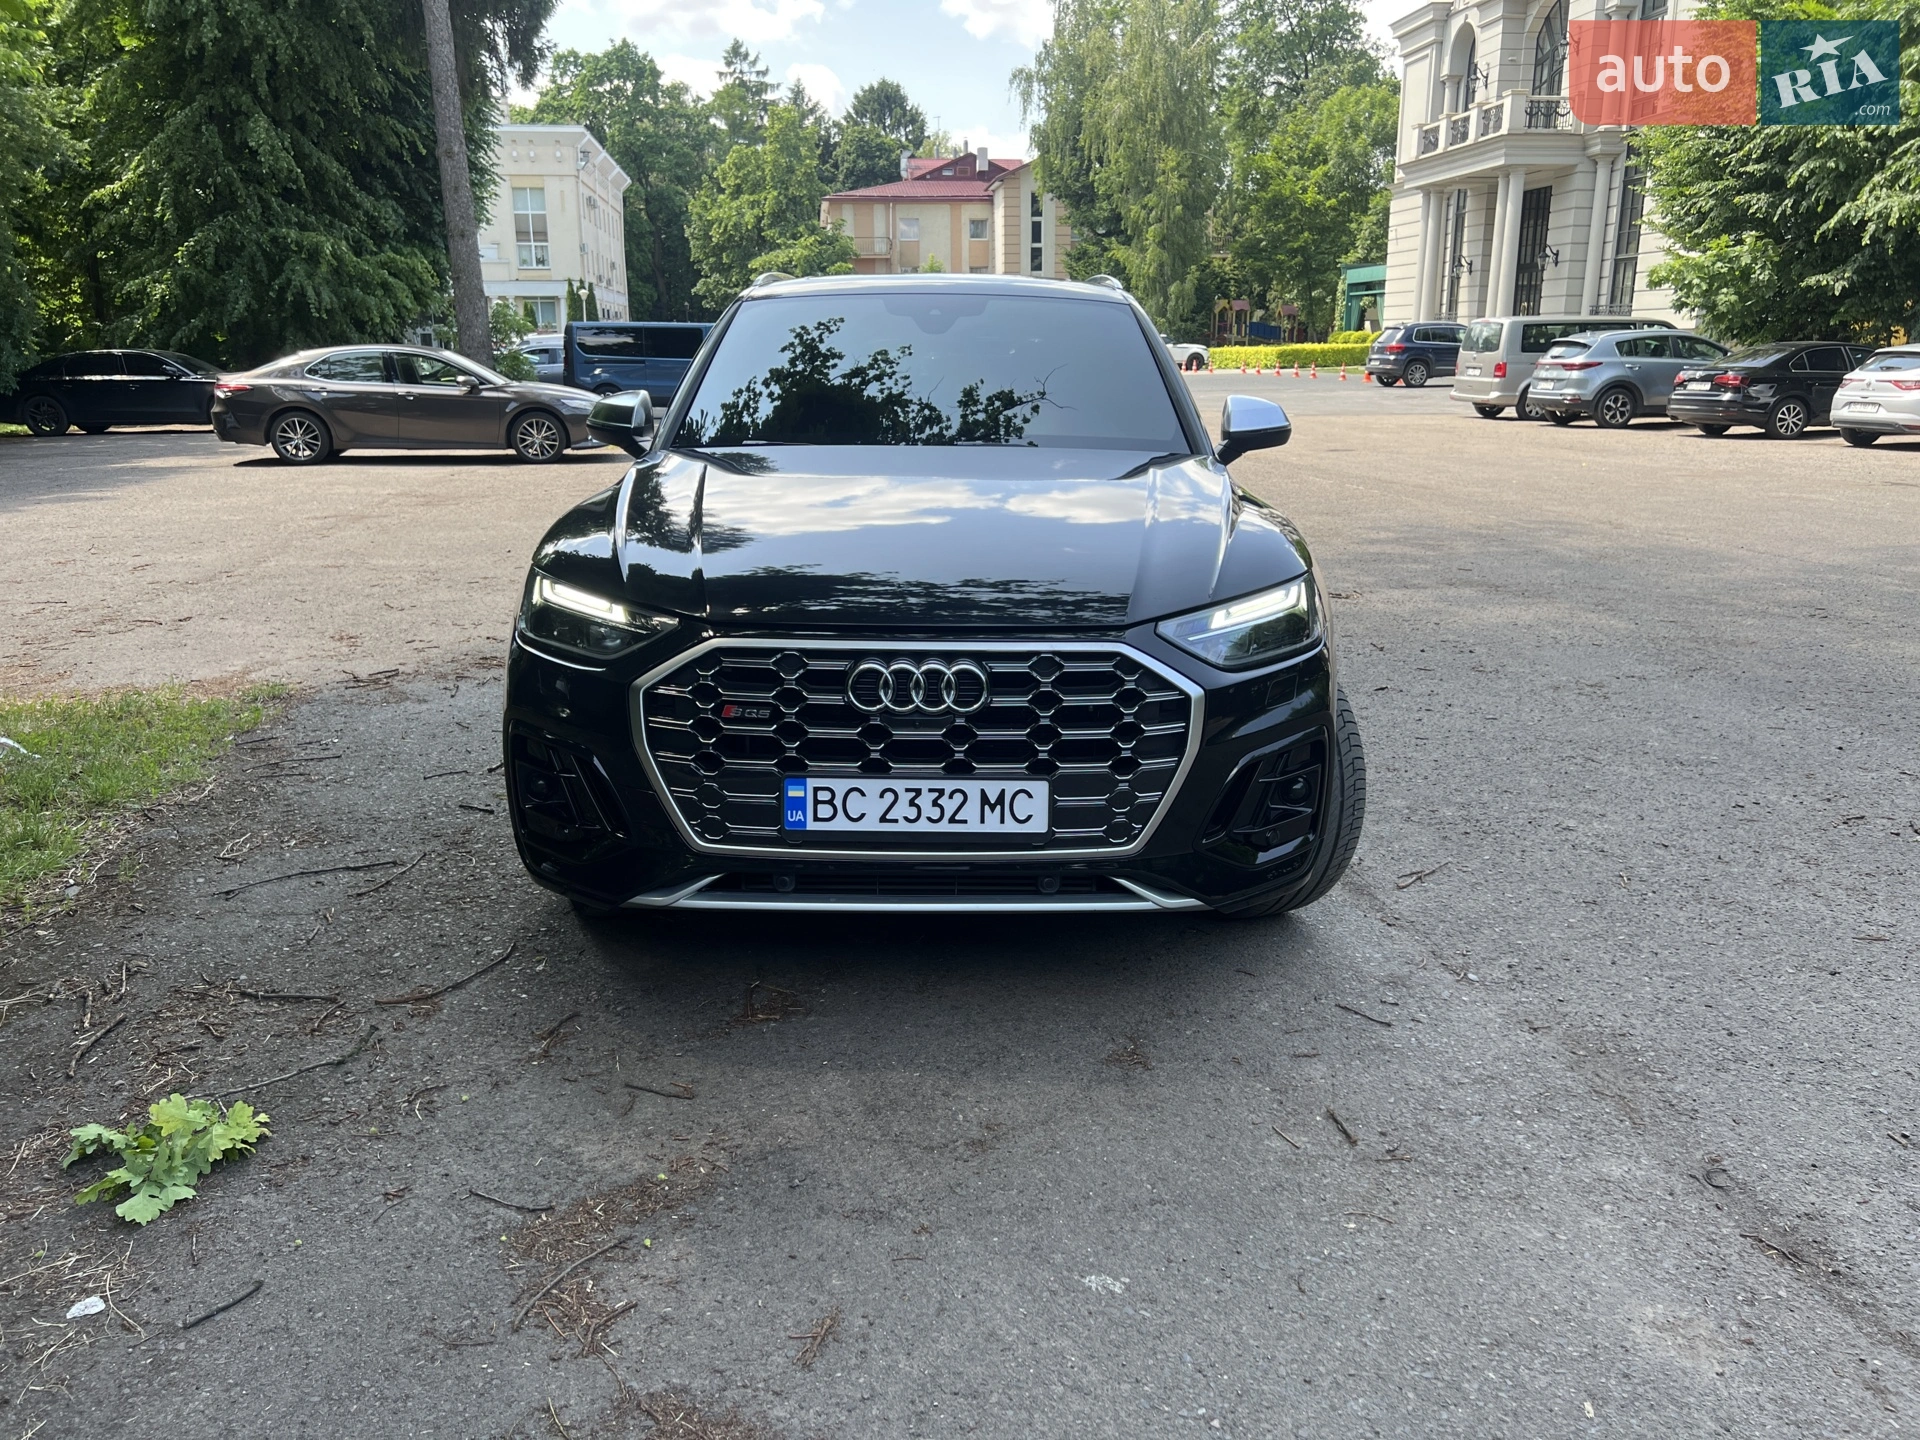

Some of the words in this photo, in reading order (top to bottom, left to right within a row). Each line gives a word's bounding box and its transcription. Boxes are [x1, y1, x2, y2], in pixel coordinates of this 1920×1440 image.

[787, 809, 805, 822] UA
[812, 785, 867, 823] BC
[878, 787, 969, 824] 2332
[979, 787, 1034, 825] MC
